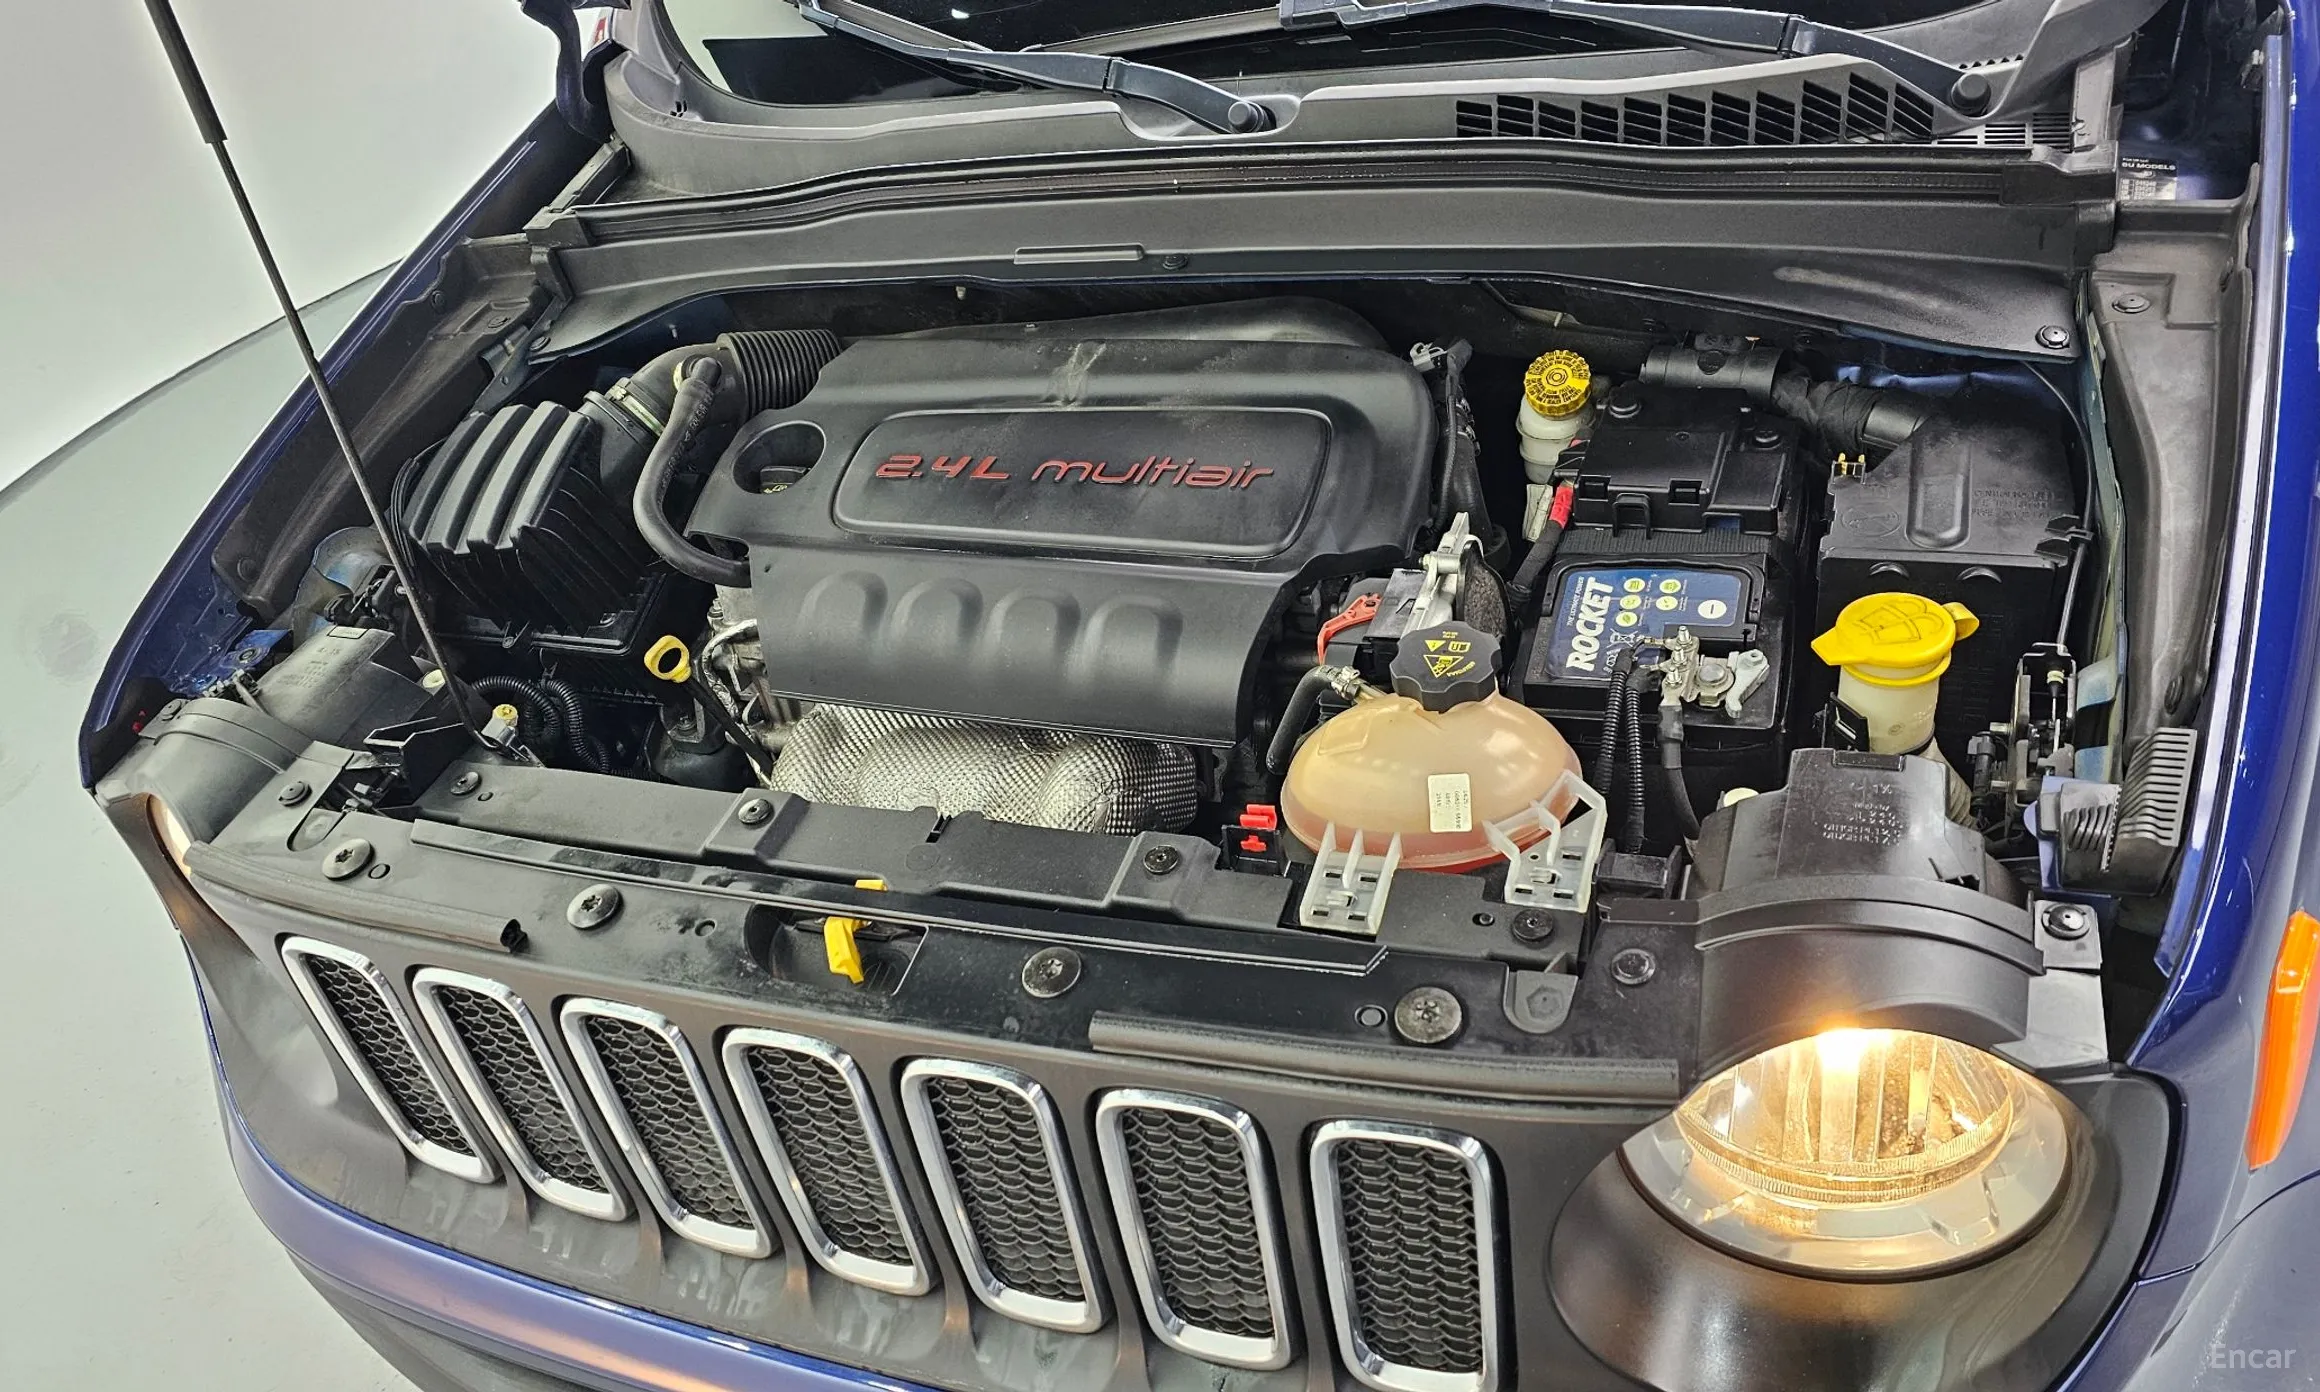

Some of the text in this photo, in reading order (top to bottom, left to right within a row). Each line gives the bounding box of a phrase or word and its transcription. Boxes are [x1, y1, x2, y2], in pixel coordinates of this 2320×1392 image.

[2136, 162, 2177, 171] MODELS
[1031, 455, 1275, 489] multiair
[1566, 576, 1614, 672] ROCKET
